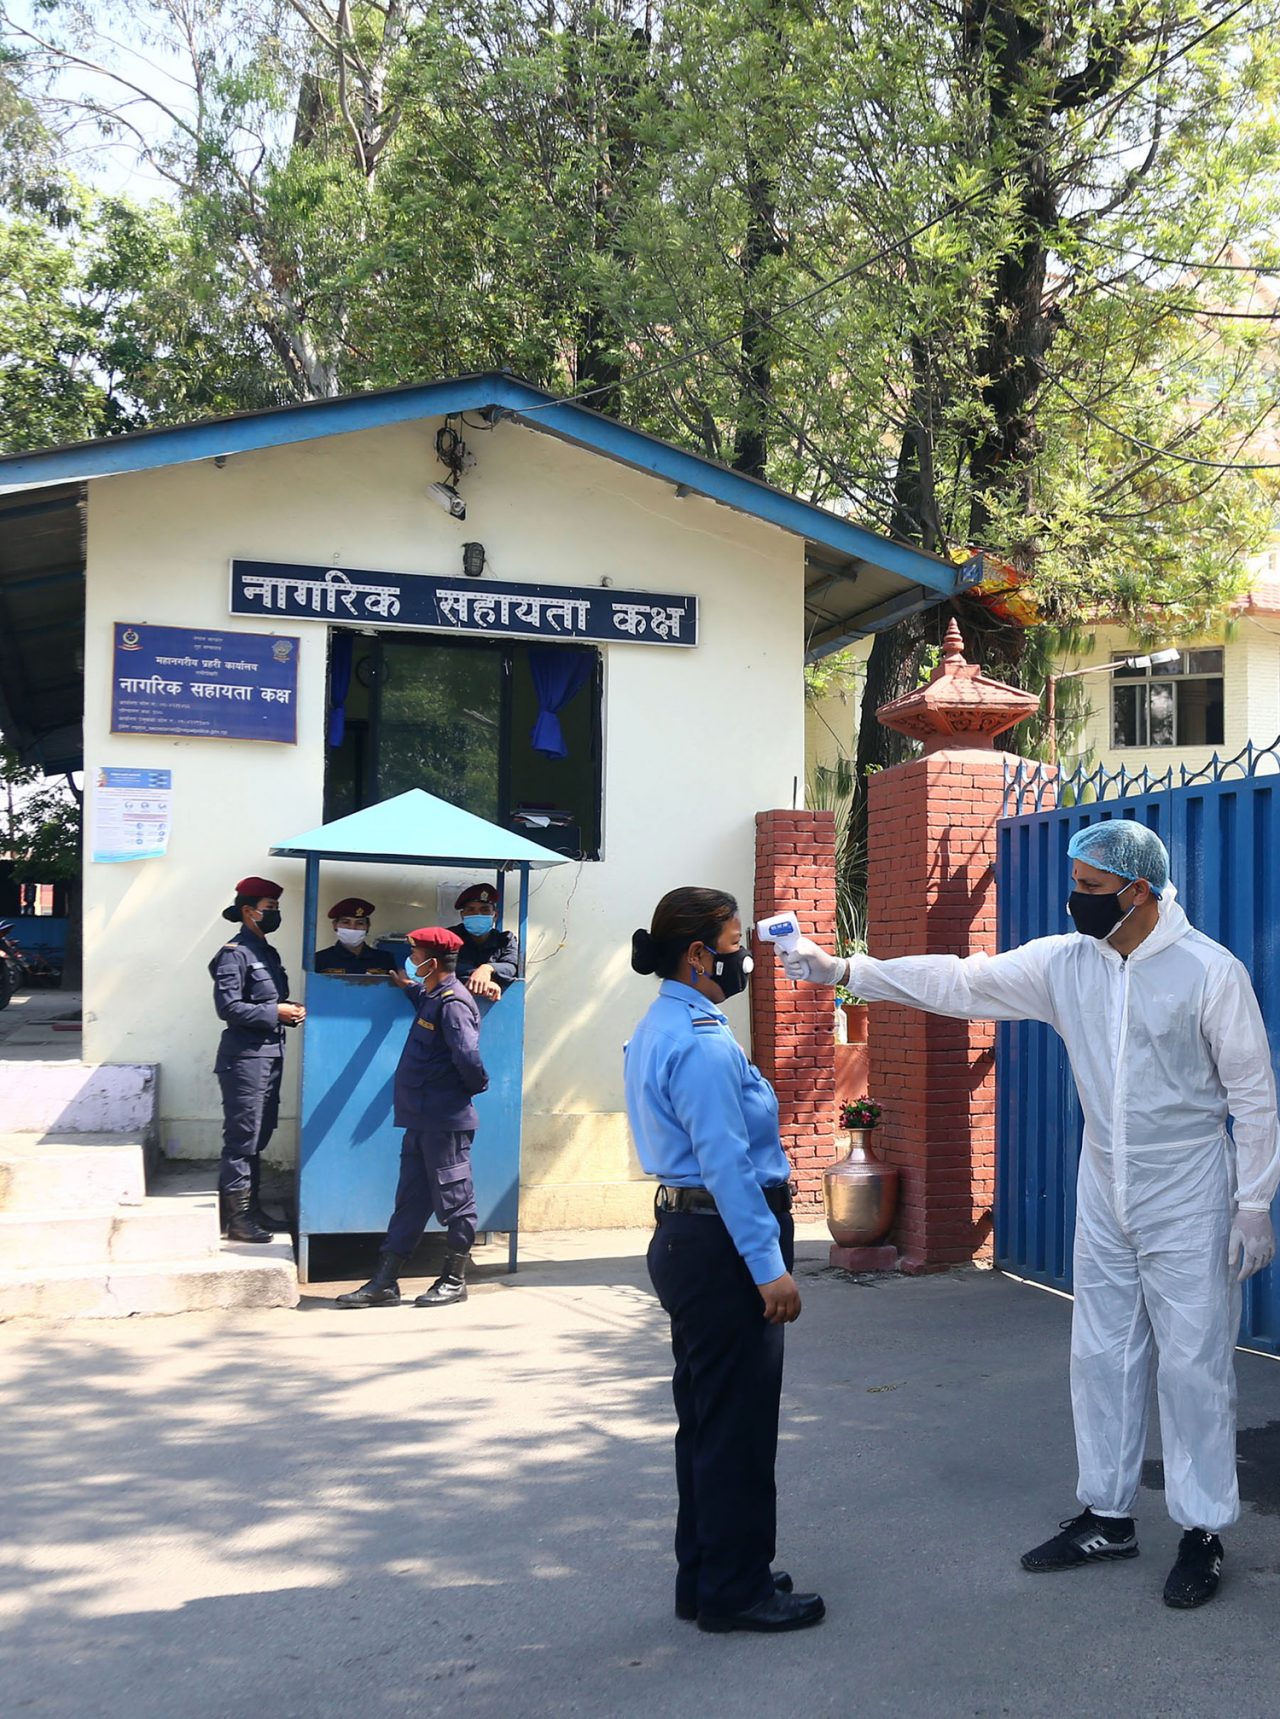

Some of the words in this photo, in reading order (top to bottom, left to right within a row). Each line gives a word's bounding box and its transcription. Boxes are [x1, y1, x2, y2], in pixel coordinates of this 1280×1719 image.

[242, 570, 400, 616] नागरिक
[435, 589, 590, 631] सहायता
[611, 603, 685, 640] कक्ष
[155, 656, 198, 667] महानगरीय
[202, 658, 221, 670] प्रहरी
[225, 660, 258, 672] कार्यालय
[119, 675, 183, 696] नागरिक
[190, 682, 254, 700] सहायता
[260, 687, 292, 704] कक्ष
